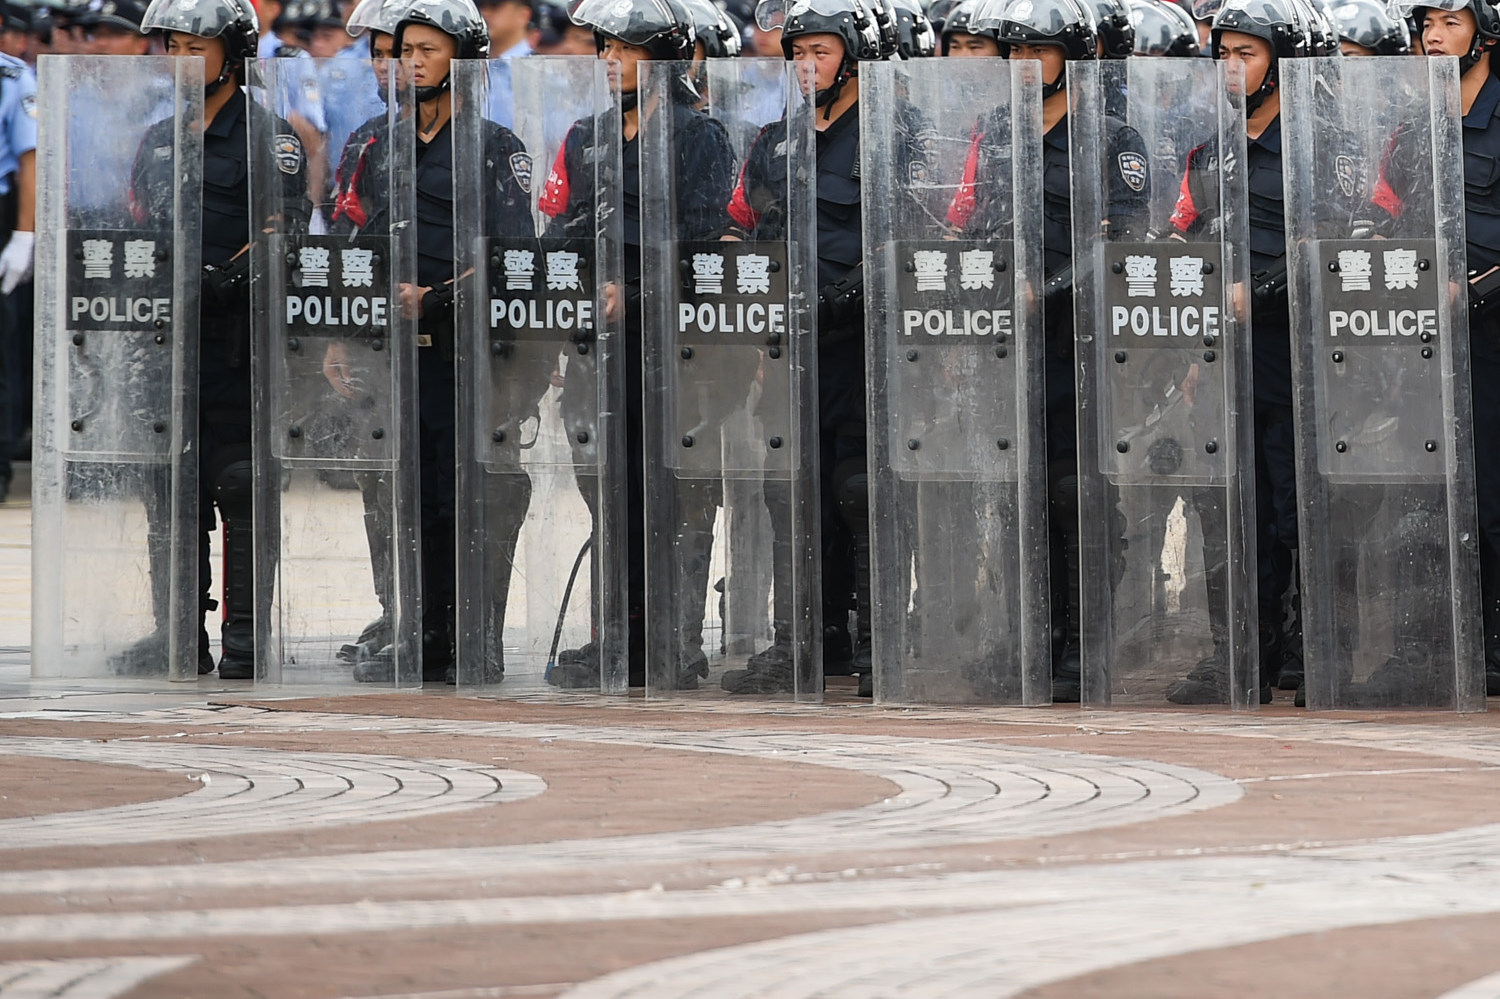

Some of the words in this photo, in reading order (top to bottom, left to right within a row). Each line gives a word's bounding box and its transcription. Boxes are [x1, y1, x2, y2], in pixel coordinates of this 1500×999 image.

[82, 239, 157, 280] 警察
[299, 247, 374, 288] 警察
[504, 250, 580, 291] 警察
[692, 252, 771, 295] 警察
[912, 249, 995, 291] 警察
[1125, 255, 1204, 297] 警察
[1337, 248, 1419, 291] 警察
[71, 297, 171, 323] POLICE
[286, 296, 388, 327] POLICE
[490, 299, 593, 330] POLICE
[678, 303, 785, 333] POLICE
[903, 309, 1012, 336] POLICE
[1112, 305, 1220, 336] POLICE
[1329, 309, 1437, 337] POLICE
